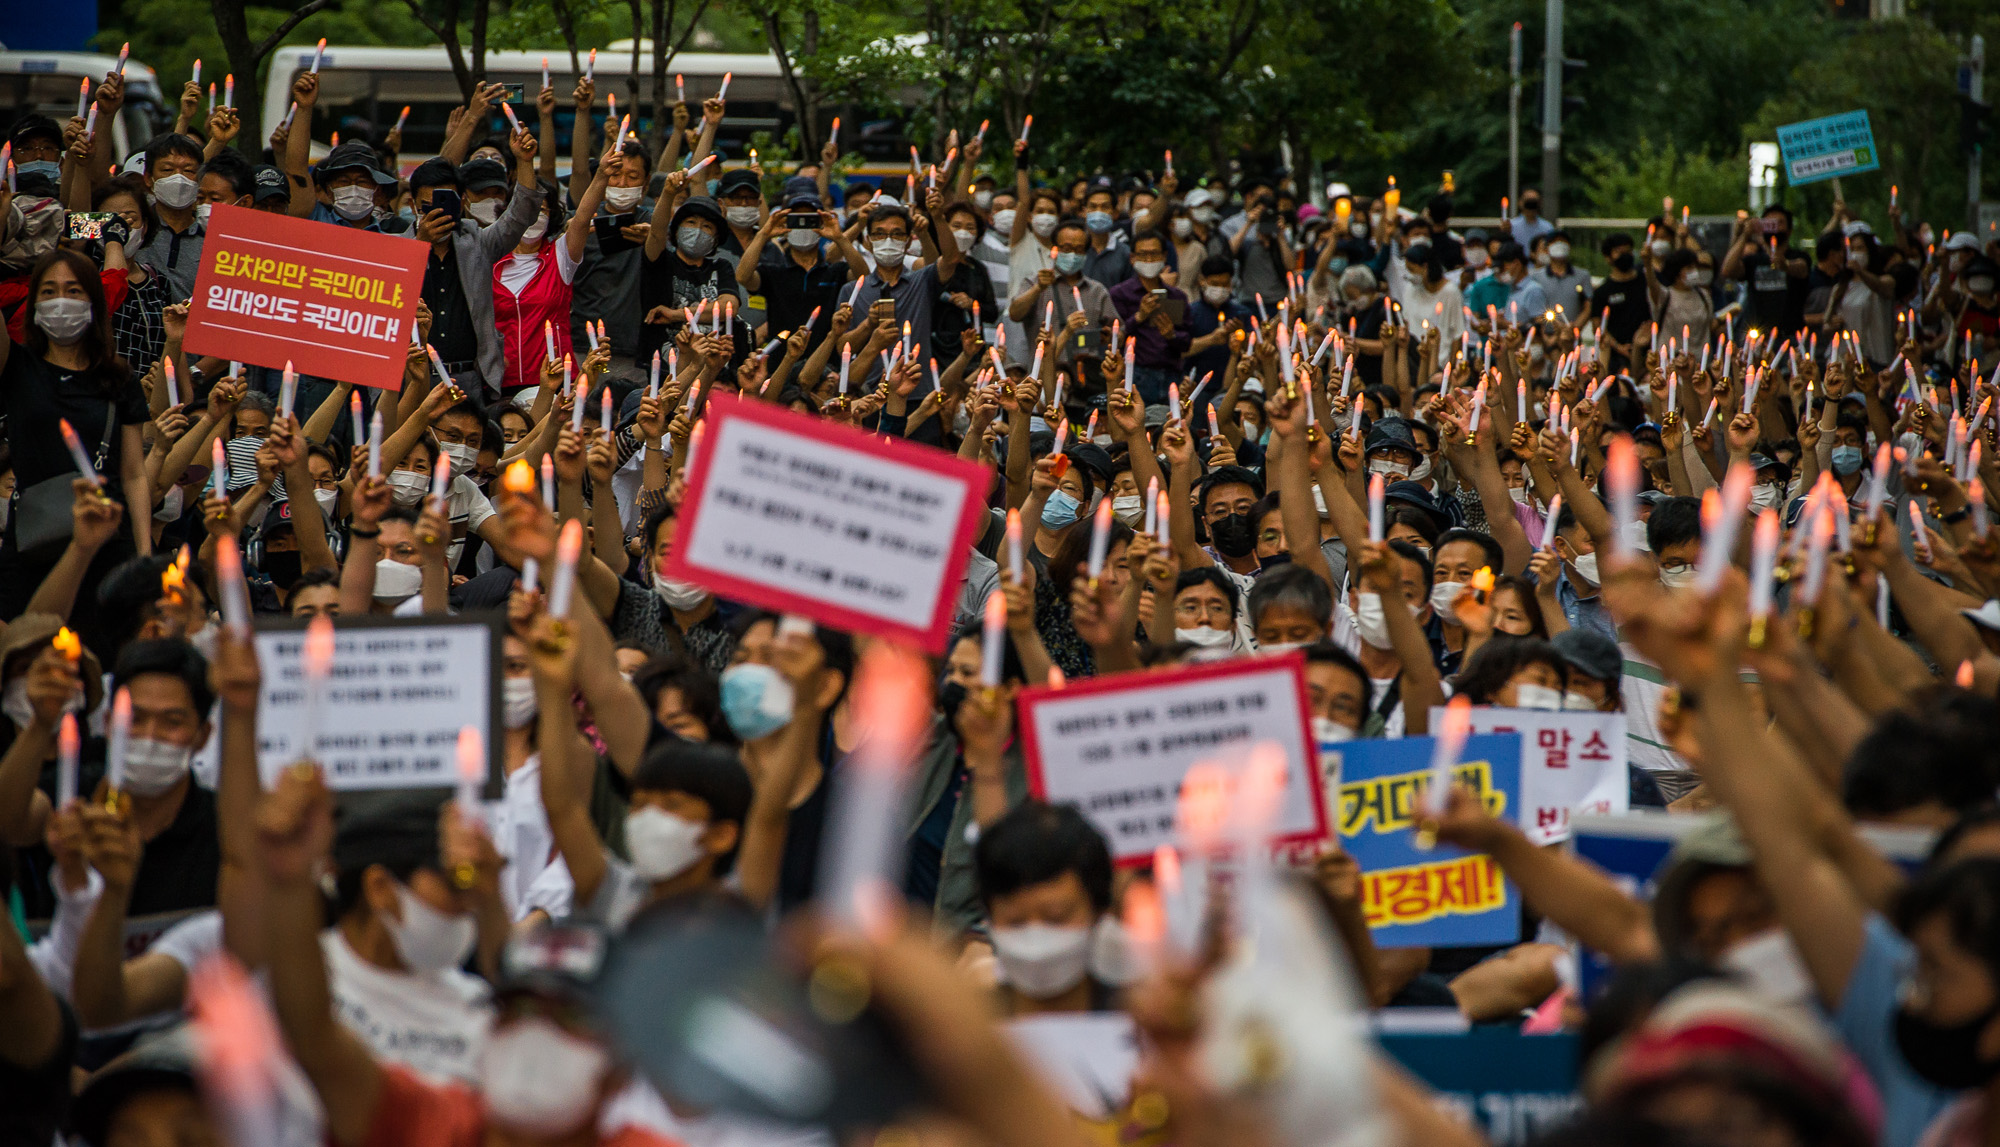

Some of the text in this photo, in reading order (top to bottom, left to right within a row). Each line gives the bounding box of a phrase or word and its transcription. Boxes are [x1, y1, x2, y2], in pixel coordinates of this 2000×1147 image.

[214, 250, 404, 309] 임차인만 국민이냐,
[206, 285, 400, 343] 임대인도 국민이다!
[1537, 728, 1612, 769] 말소
